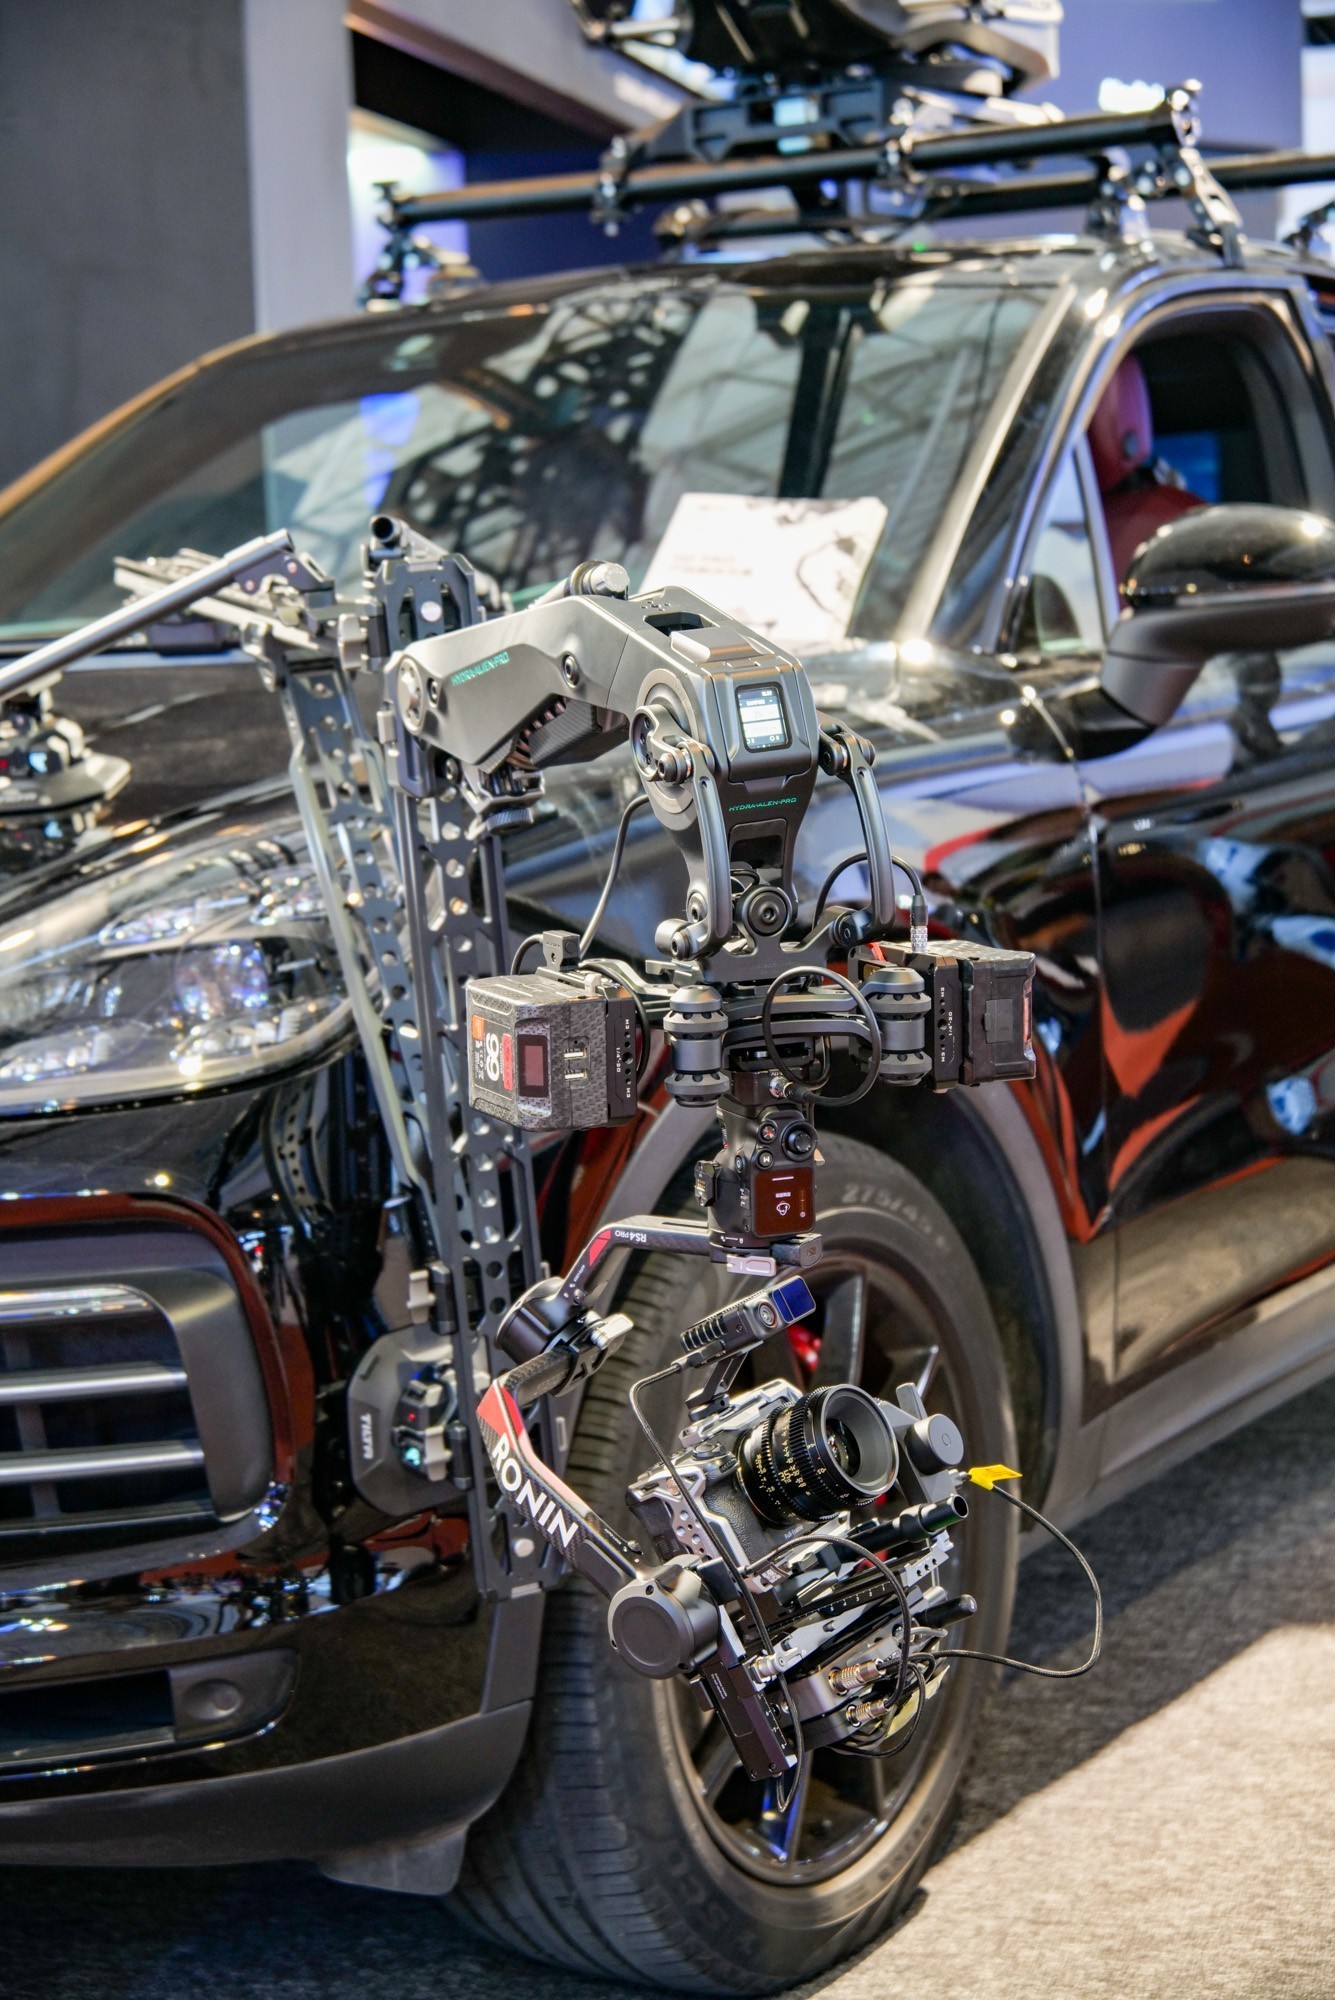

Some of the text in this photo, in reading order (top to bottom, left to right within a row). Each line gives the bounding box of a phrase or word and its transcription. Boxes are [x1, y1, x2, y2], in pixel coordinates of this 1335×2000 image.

[486, 1033, 500, 1081] 99
[614, 1229, 630, 1239] PRO
[360, 1412, 374, 1460] TILTA
[491, 1432, 579, 1548] RONIN
